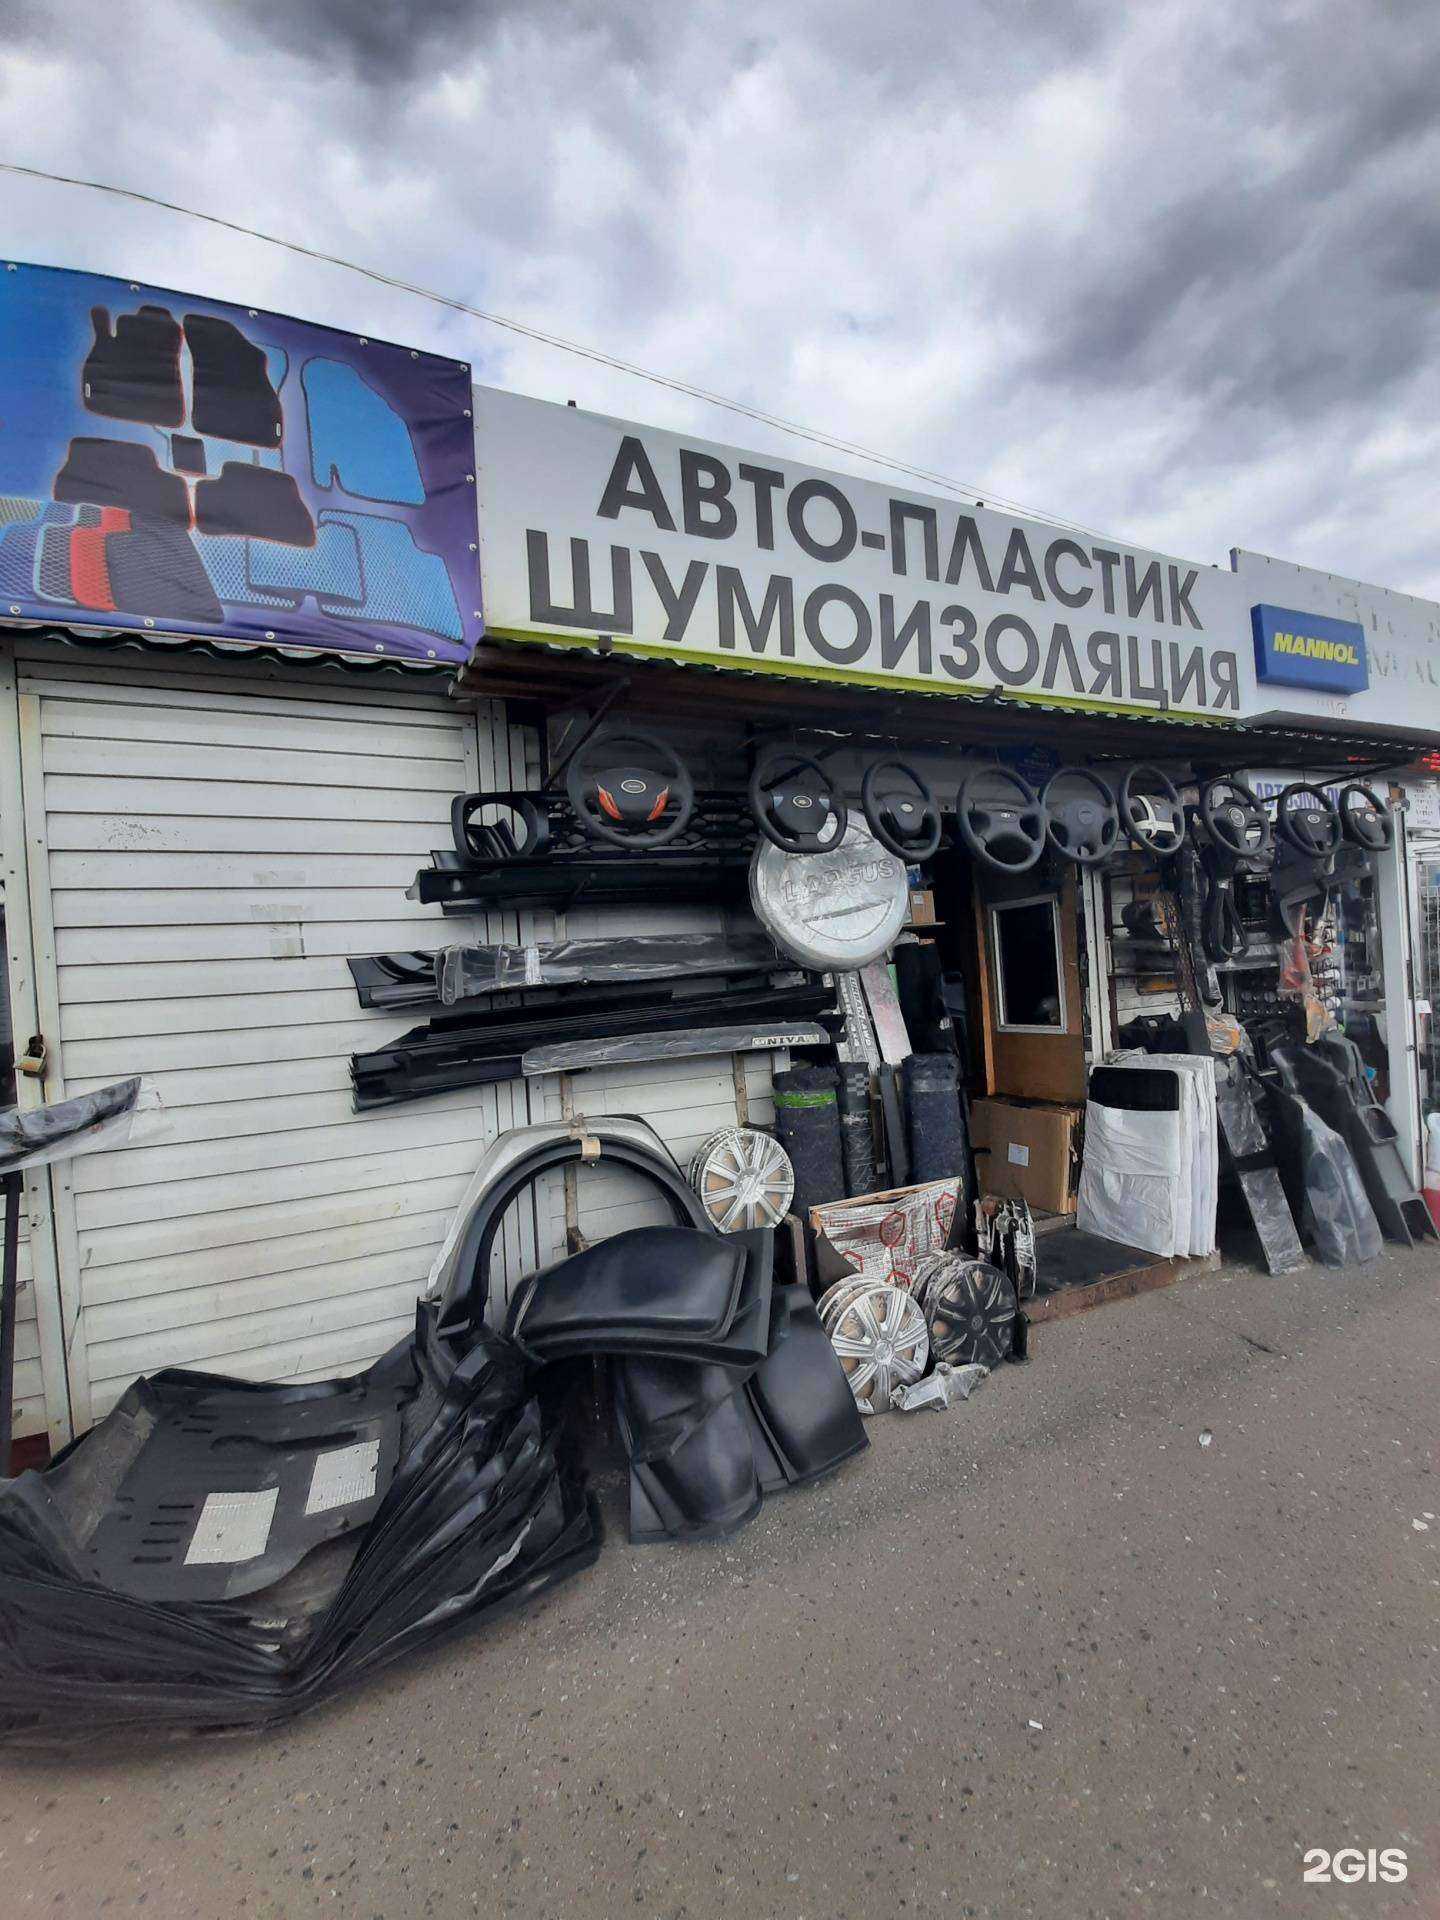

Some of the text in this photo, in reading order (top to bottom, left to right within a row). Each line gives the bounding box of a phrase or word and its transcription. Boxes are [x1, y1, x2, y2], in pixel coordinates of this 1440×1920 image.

[597, 435, 1203, 630] АВТО-ПЛАСТИК
[526, 528, 1240, 712] ШУМОИЗОЛЯЦИЯ
[1273, 632, 1359, 665] MANNOL
[767, 1035, 806, 1045] NIVA
